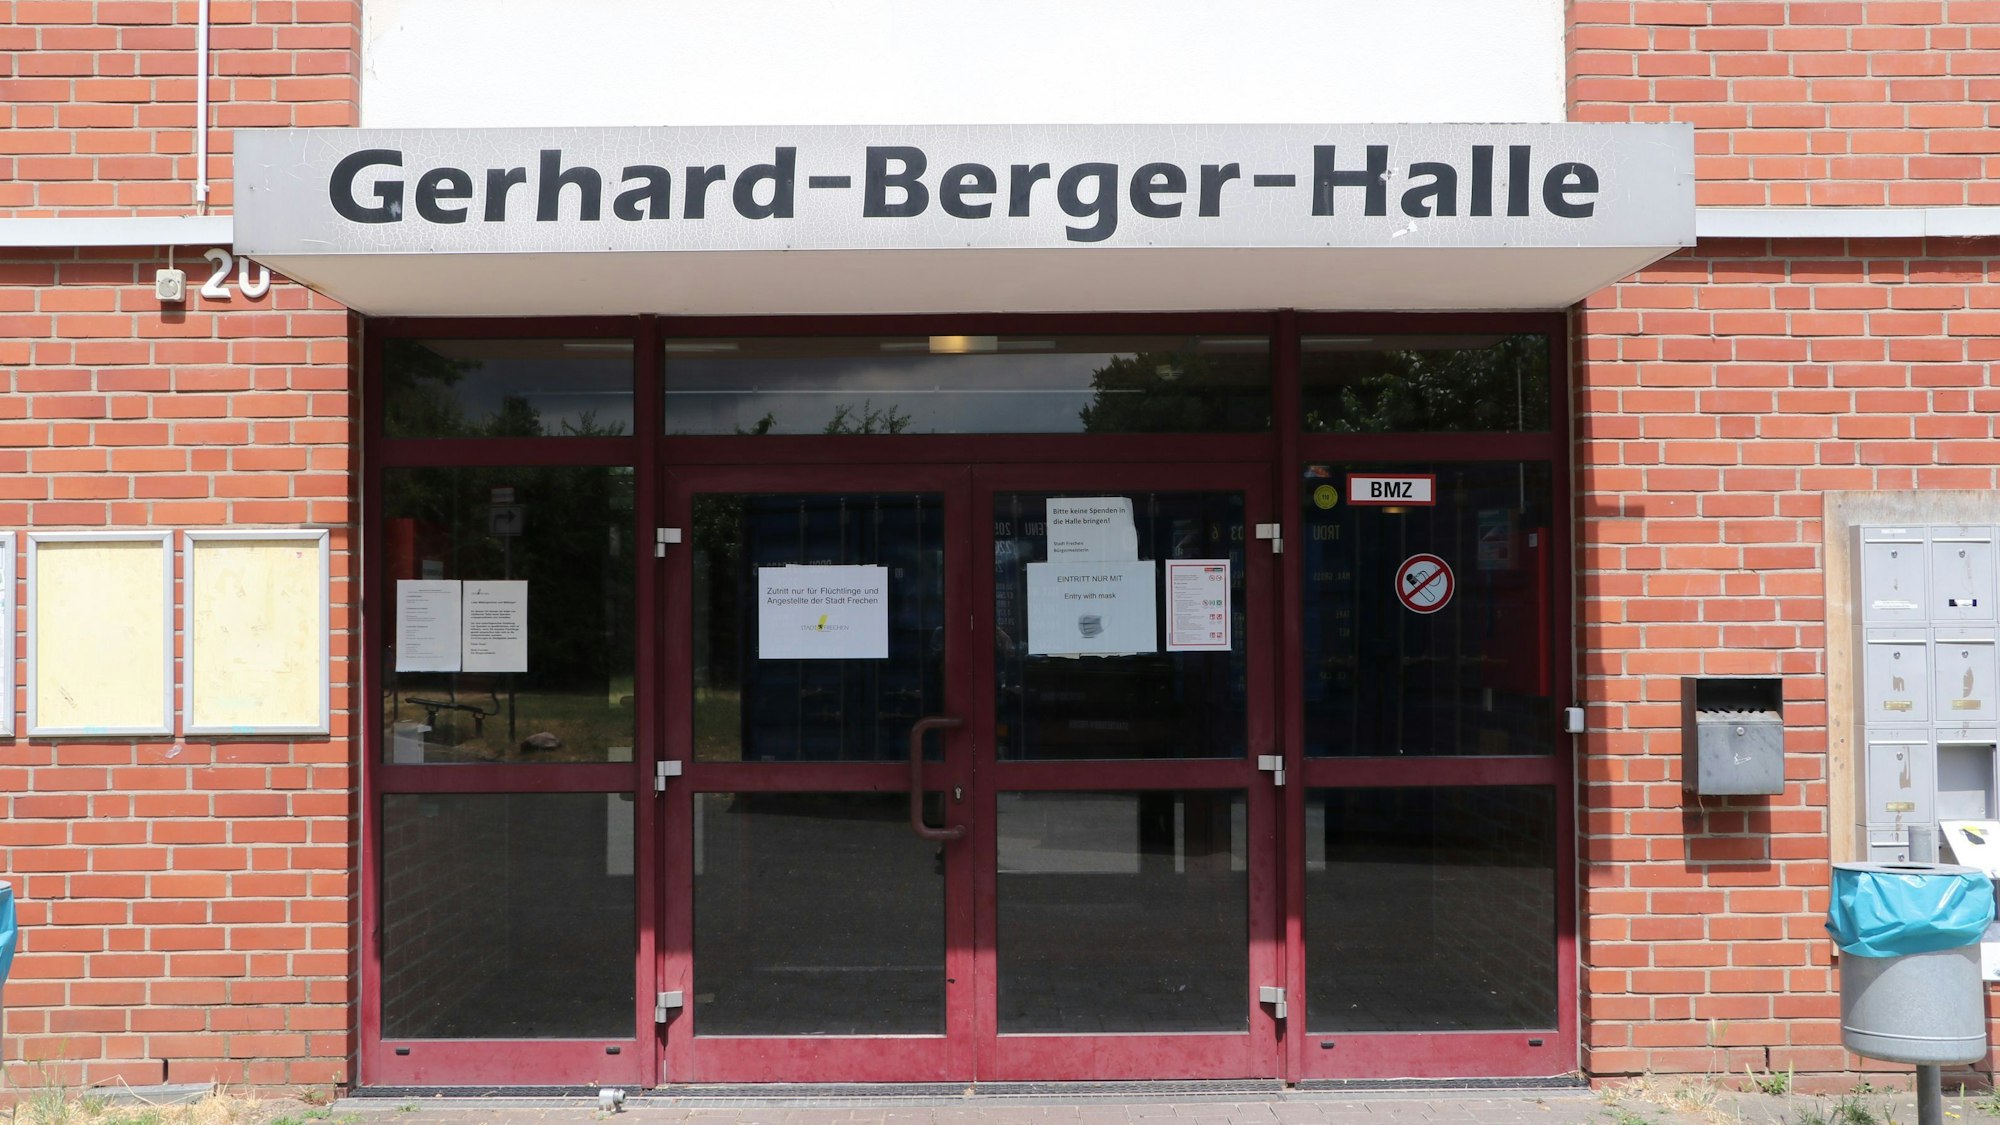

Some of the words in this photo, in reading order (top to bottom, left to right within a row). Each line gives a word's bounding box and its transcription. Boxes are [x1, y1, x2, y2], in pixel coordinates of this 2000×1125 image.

[329, 145, 1599, 242] Gerhard-Berger-Halle
[201, 248, 270, 298] 20
[1370, 481, 1413, 498] BMZ
[1089, 508, 1118, 516] Spenden
[1082, 518, 1111, 526] bringen!
[820, 588, 861, 597] Flüchtlinge
[767, 597, 809, 606] Angestellte
[810, 597, 824, 605] der
[825, 597, 845, 605] Stadt
[847, 597, 879, 605] Frechen
